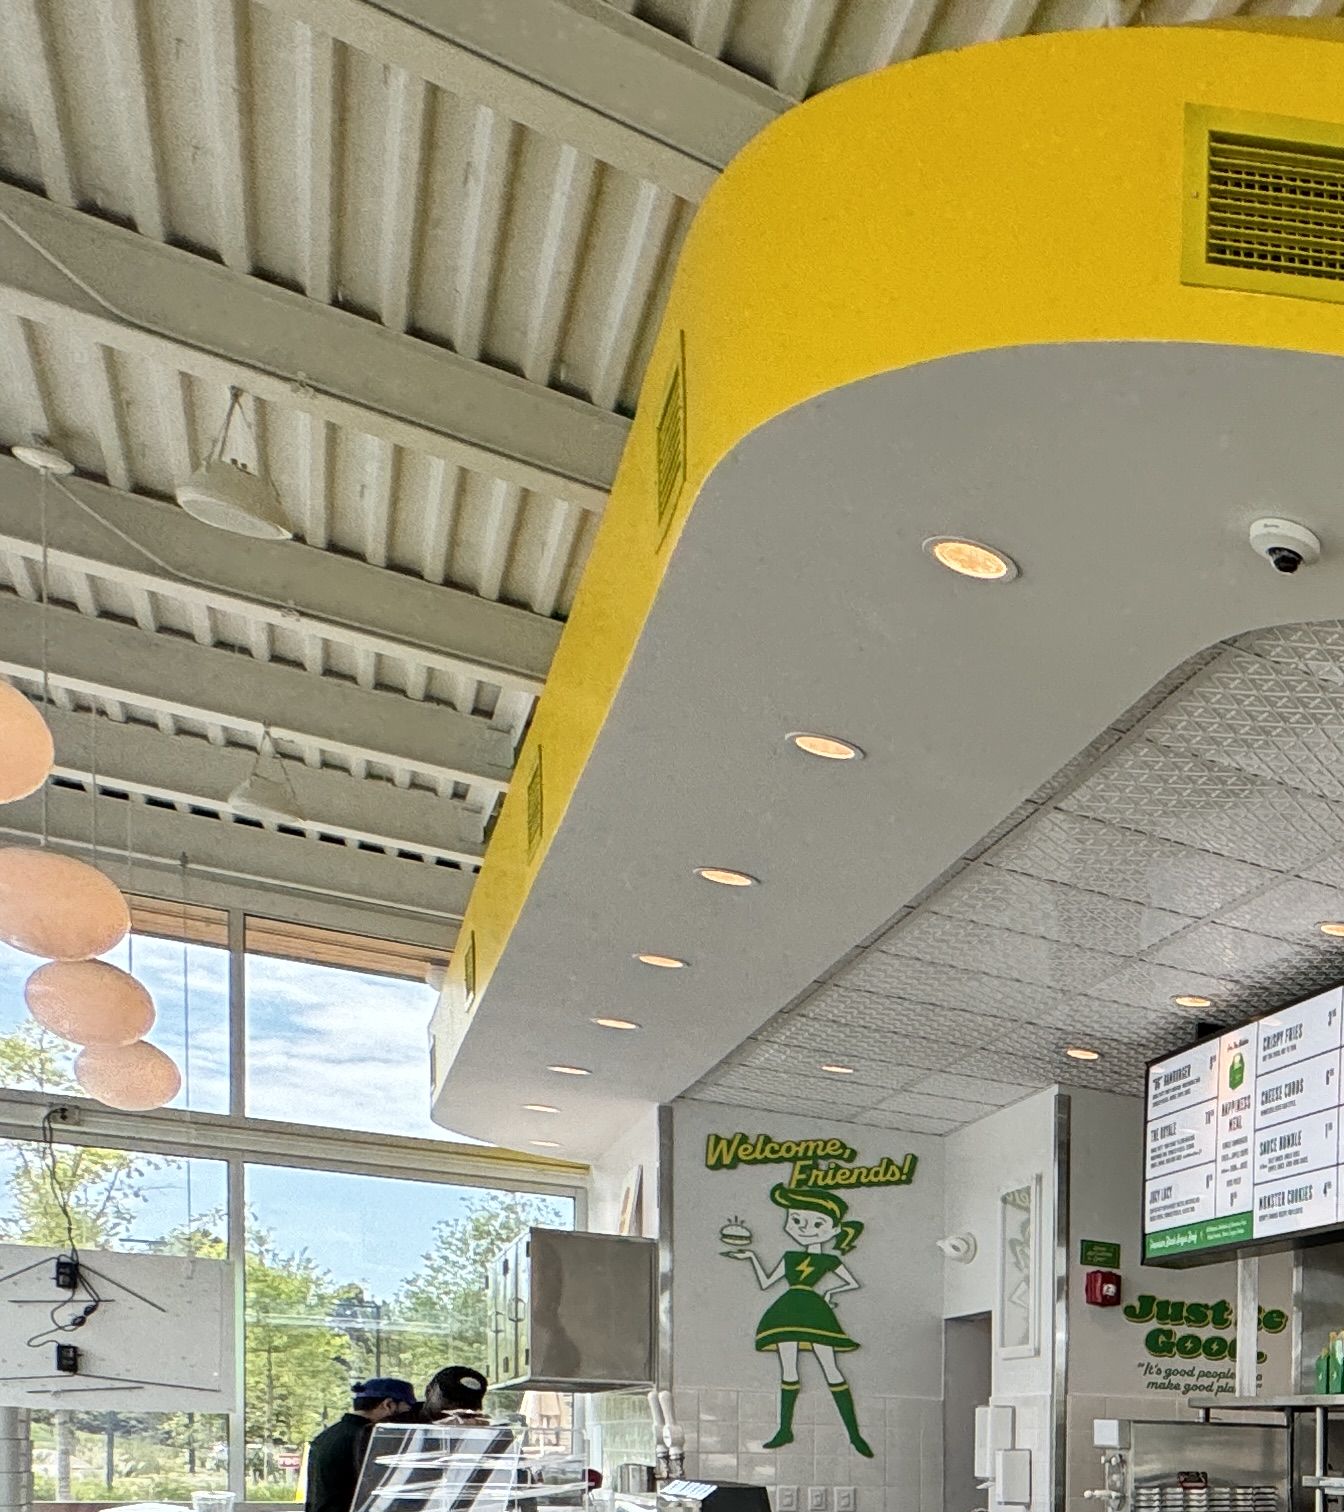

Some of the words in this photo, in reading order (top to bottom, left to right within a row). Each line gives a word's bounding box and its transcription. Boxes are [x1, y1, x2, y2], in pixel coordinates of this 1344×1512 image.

[1263, 1031, 1284, 1051] CRISPY
[1285, 1023, 1303, 1043] FRIES
[1261, 1085, 1282, 1105] CHEESE
[706, 1132, 857, 1170] Welcome,
[788, 1153, 918, 1189] Friends!
[1123, 1295, 1233, 1330] Just
[1163, 1366, 1196, 1380] good
[1146, 1380, 1181, 1390] make
[1182, 1382, 1215, 1395] good
